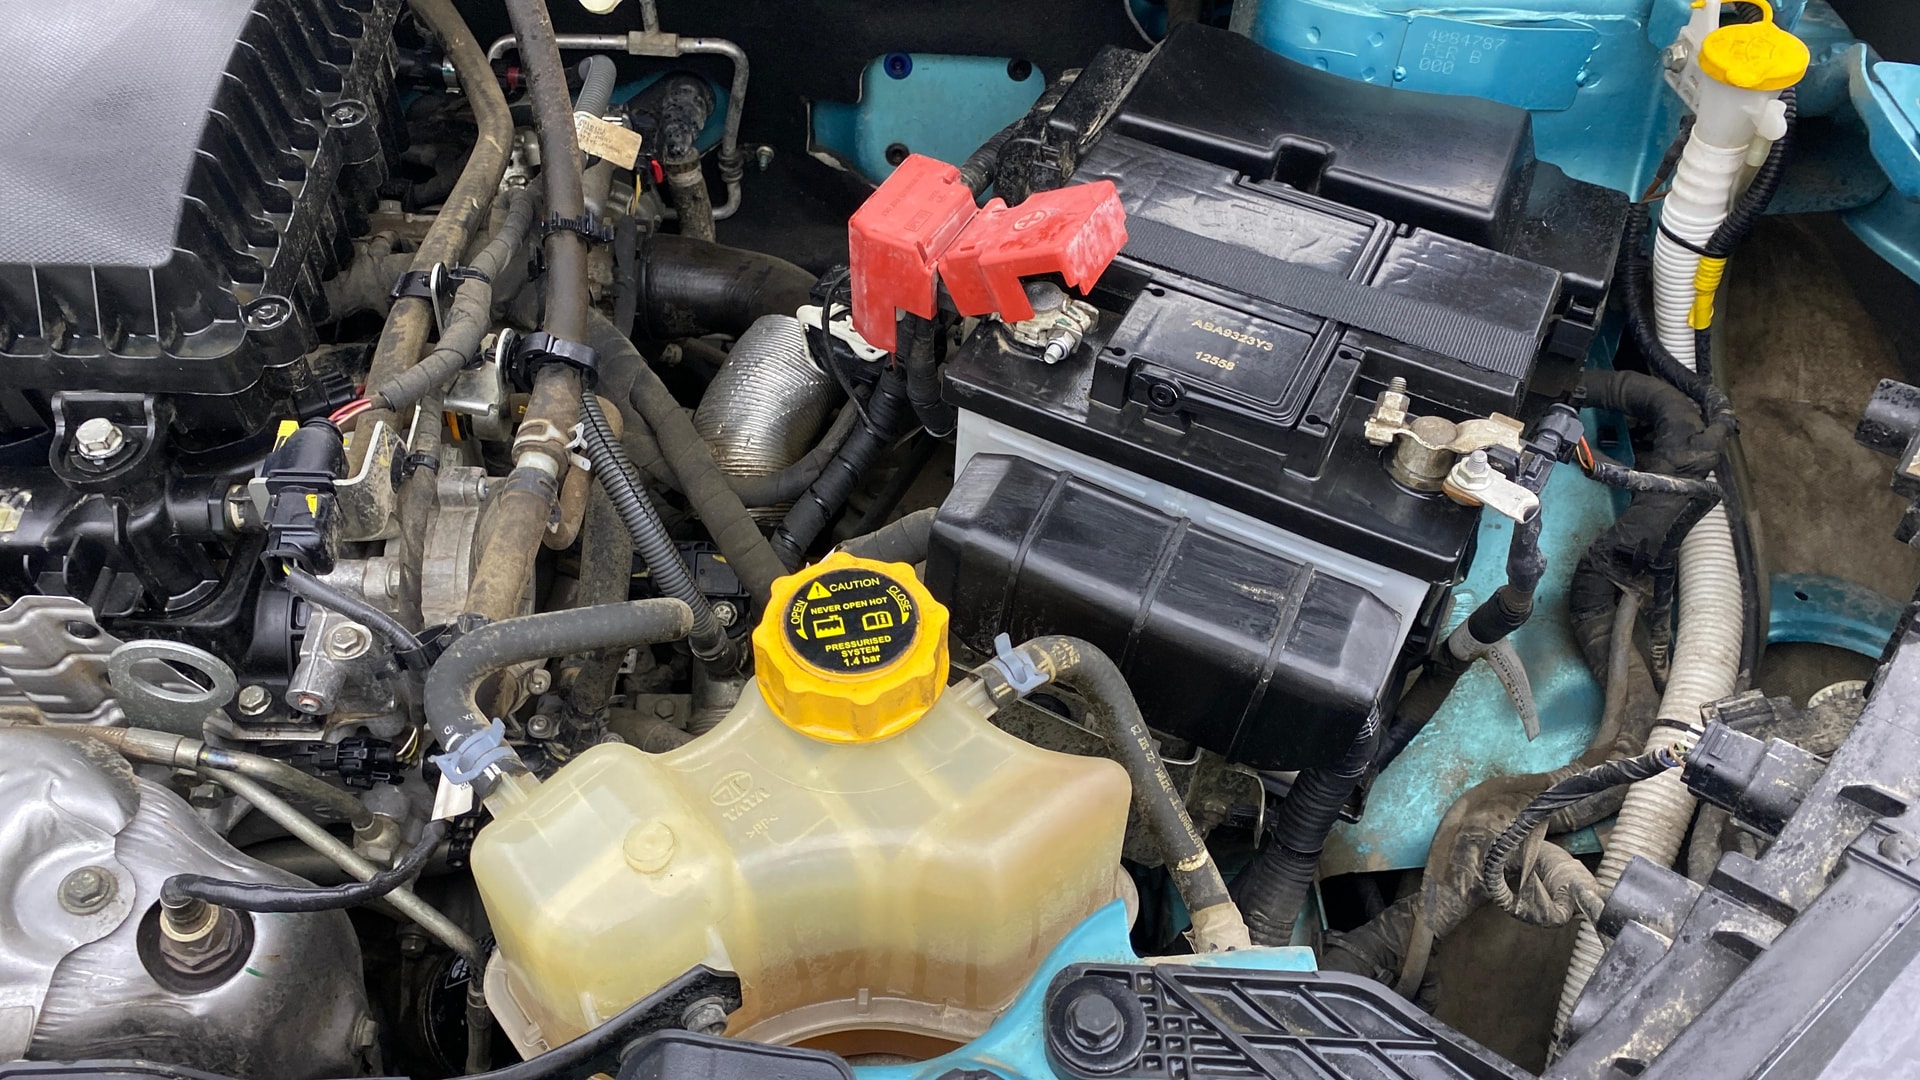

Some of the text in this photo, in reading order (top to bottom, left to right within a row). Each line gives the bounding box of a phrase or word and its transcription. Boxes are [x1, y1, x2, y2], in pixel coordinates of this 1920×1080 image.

[1428, 29, 1507, 51] 4084787
[1191, 319, 1274, 351] ABA9323Y3
[1195, 351, 1235, 371] 12558
[829, 577, 880, 592] CAUTION
[810, 596, 888, 615] NEVER OPEN HOT
[888, 585, 913, 612] CLOSE
[790, 599, 806, 625] OPEN
[825, 635, 892, 652] PRESSURISED
[841, 645, 880, 658] SYSTEM
[843, 653, 881, 667] 1.4 bar
